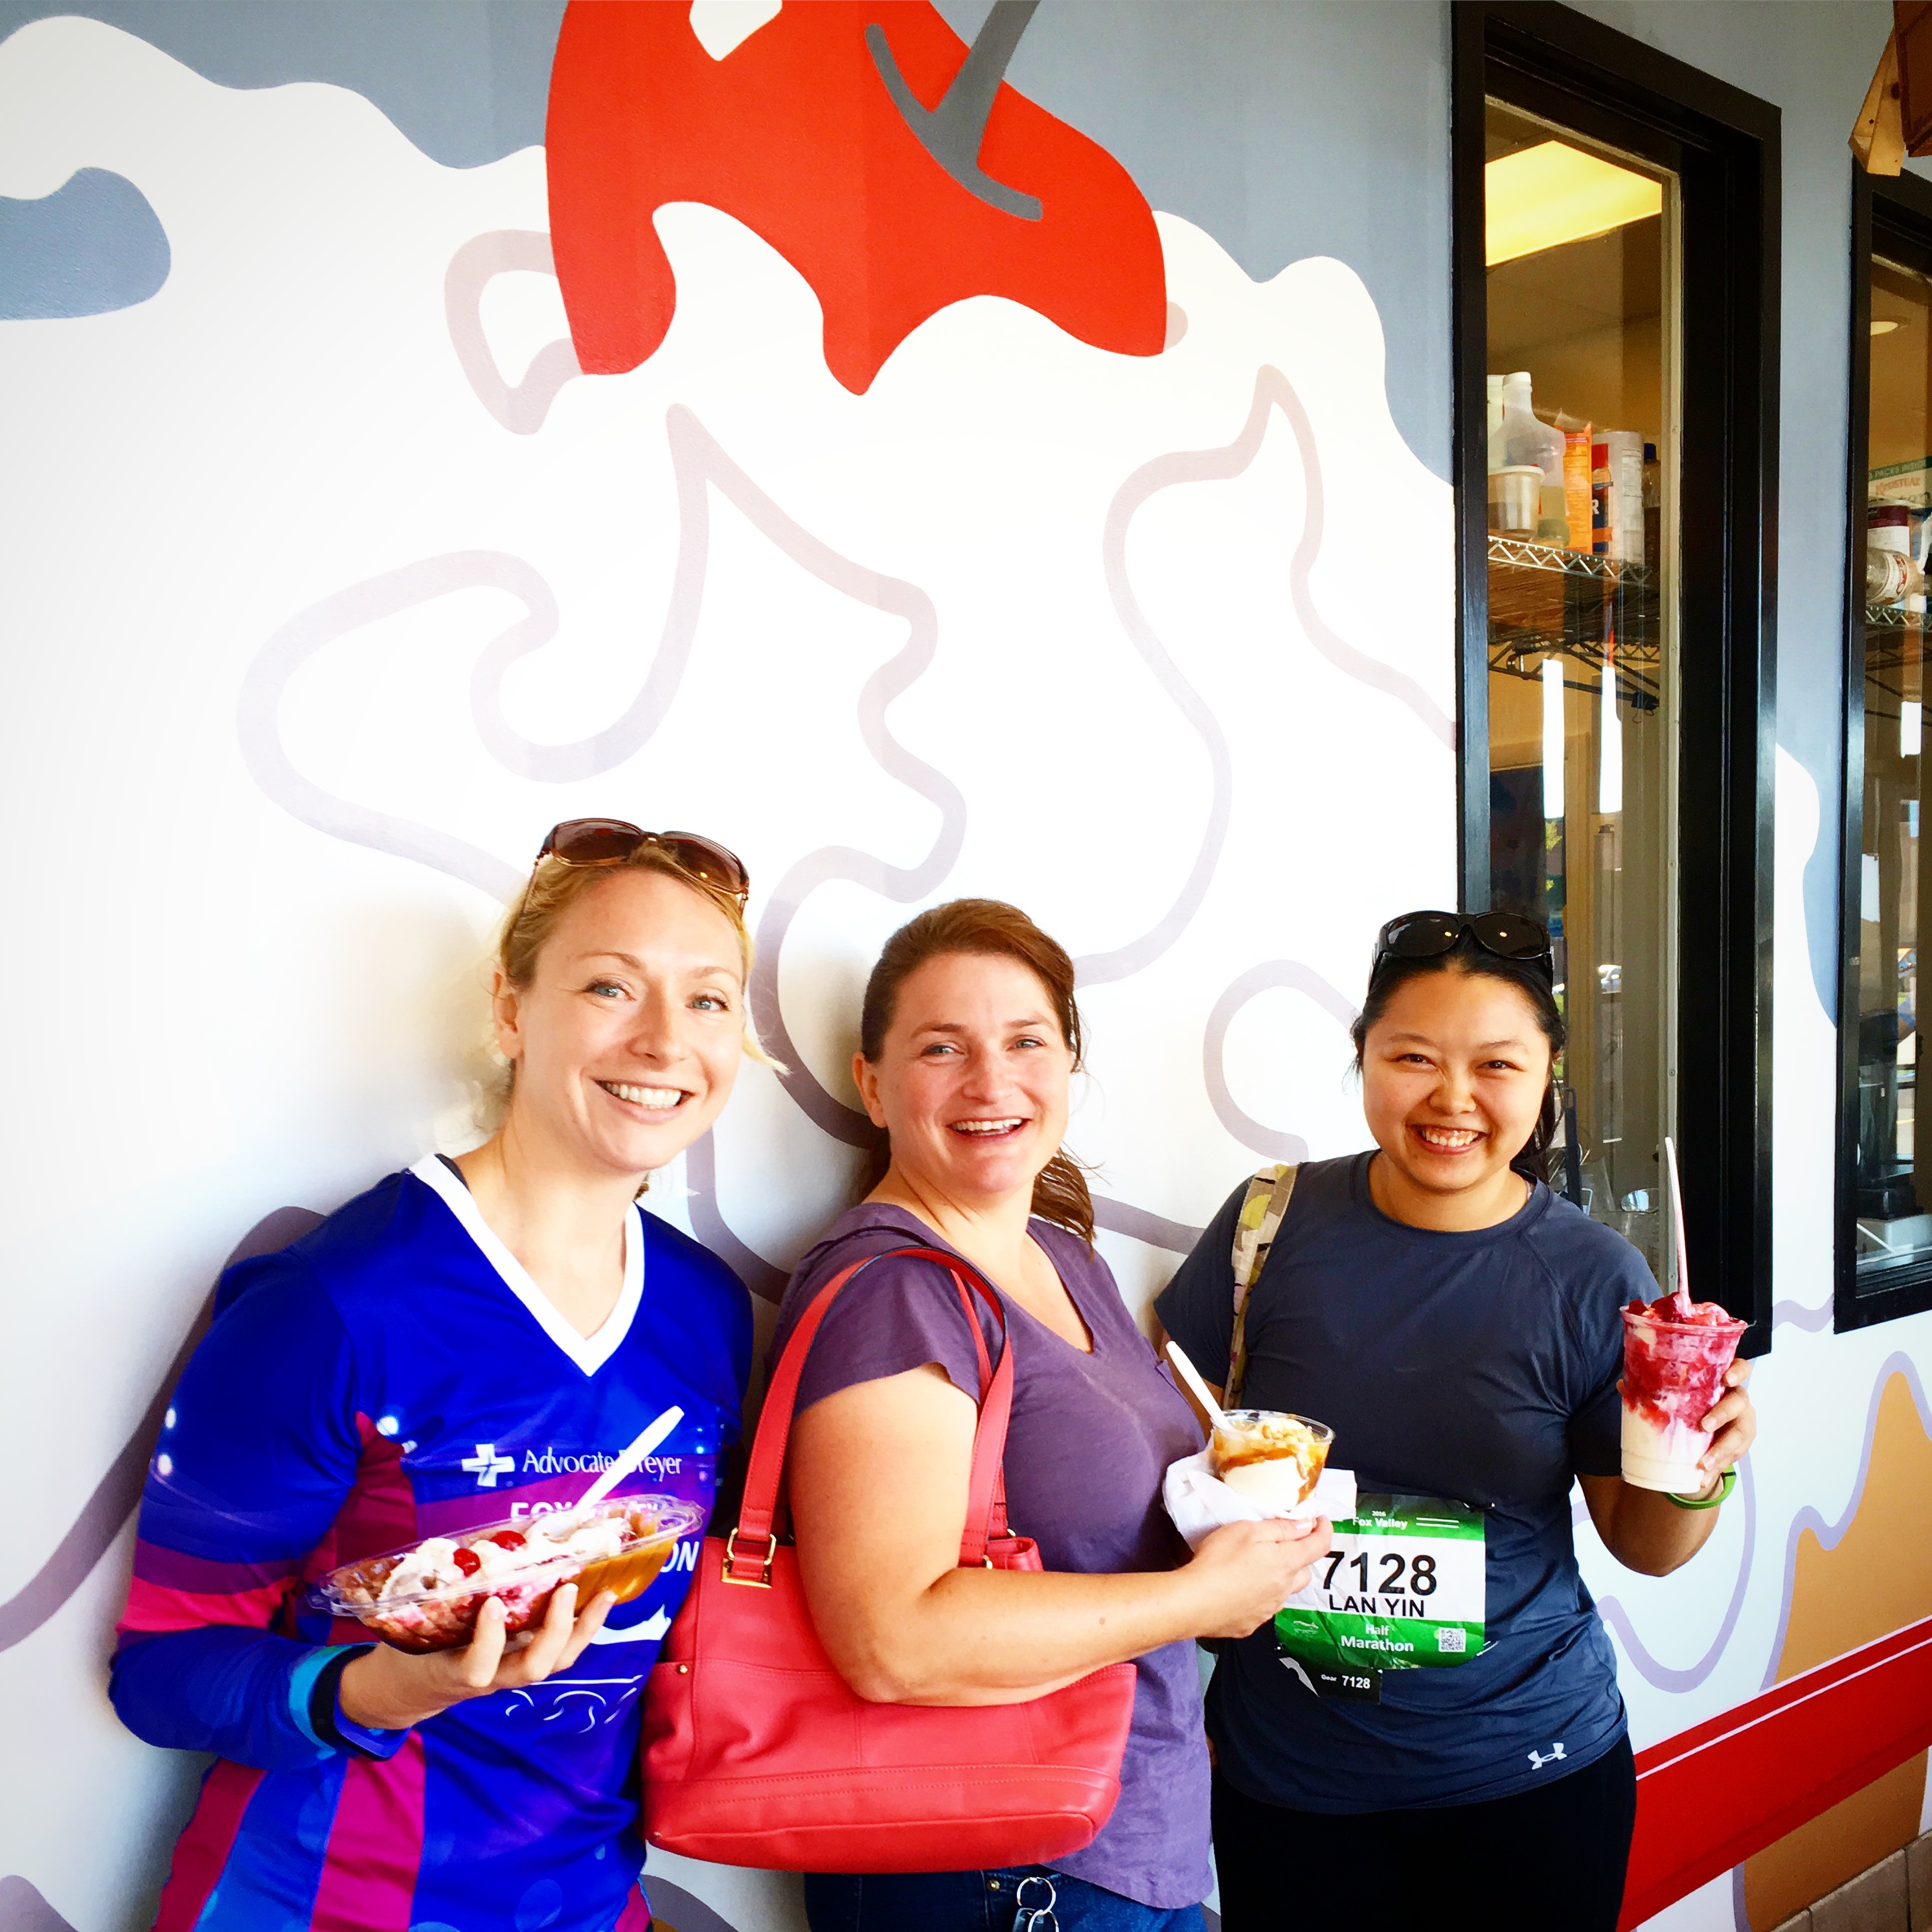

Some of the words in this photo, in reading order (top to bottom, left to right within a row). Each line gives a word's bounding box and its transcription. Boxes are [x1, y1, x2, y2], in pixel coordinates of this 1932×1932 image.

[522, 1446, 616, 1473] Advocate
[619, 1449, 683, 1483] reyer
[1352, 1517, 1373, 1527] Fox
[1374, 1517, 1408, 1530] Valley
[1323, 1551, 1437, 1596] 7128
[1329, 1594, 1377, 1614] LAN
[1384, 1598, 1424, 1618] YIN
[1365, 1624, 1390, 1636] Half
[1341, 1635, 1415, 1652] Marathon
[1321, 1674, 1337, 1682] Gear
[1341, 1675, 1371, 1690] 7128
